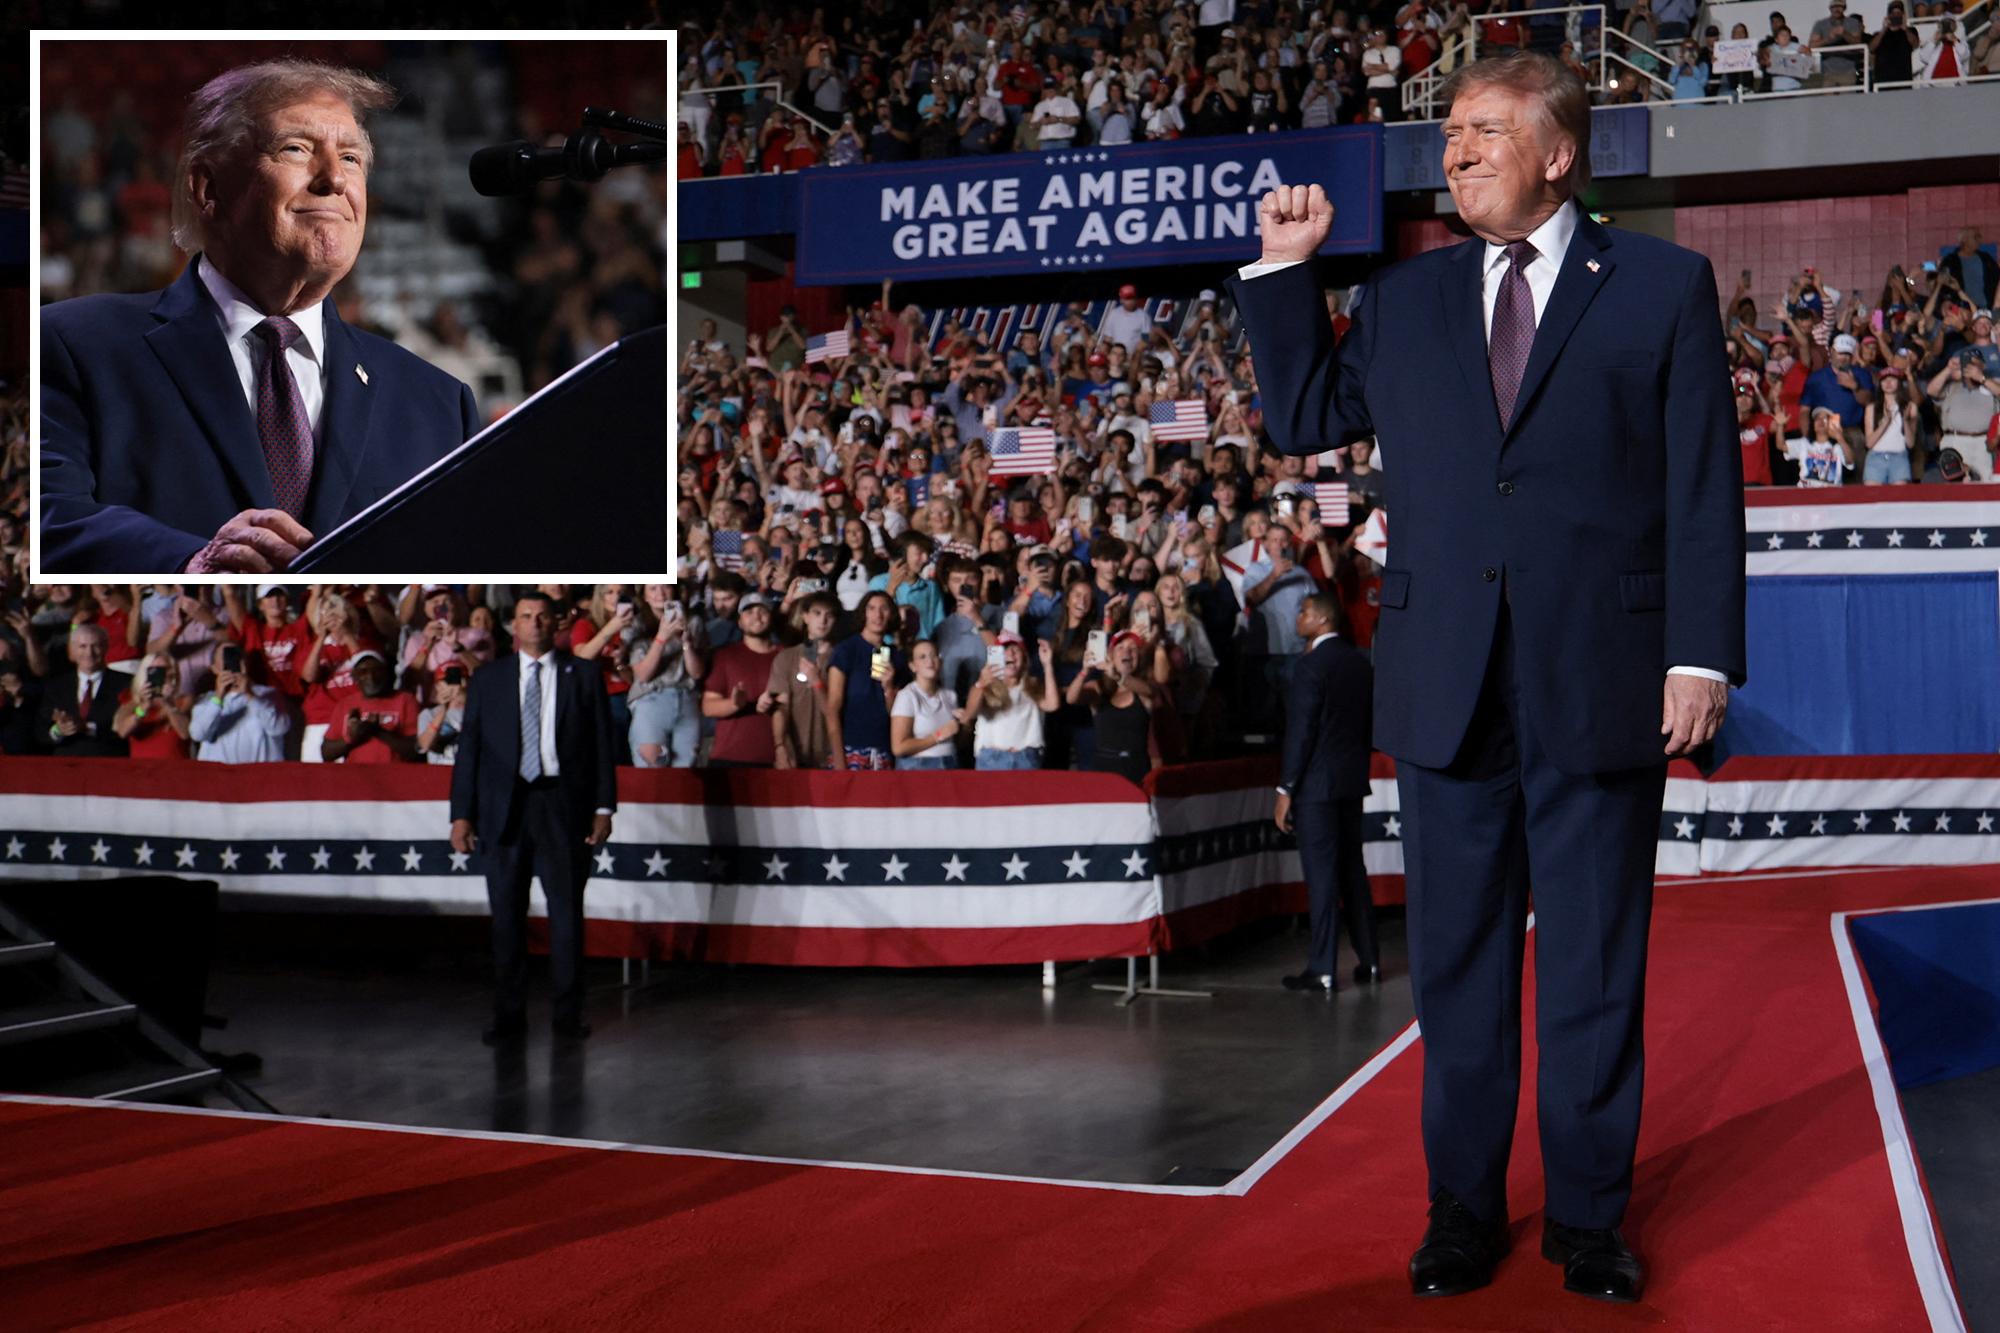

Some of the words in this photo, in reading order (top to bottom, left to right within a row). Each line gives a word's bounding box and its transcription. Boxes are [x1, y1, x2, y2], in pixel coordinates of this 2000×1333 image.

[880, 178, 1020, 222] MAKE
[1038, 158, 1283, 211] AMERICA
[892, 214, 1058, 260] GREAT
